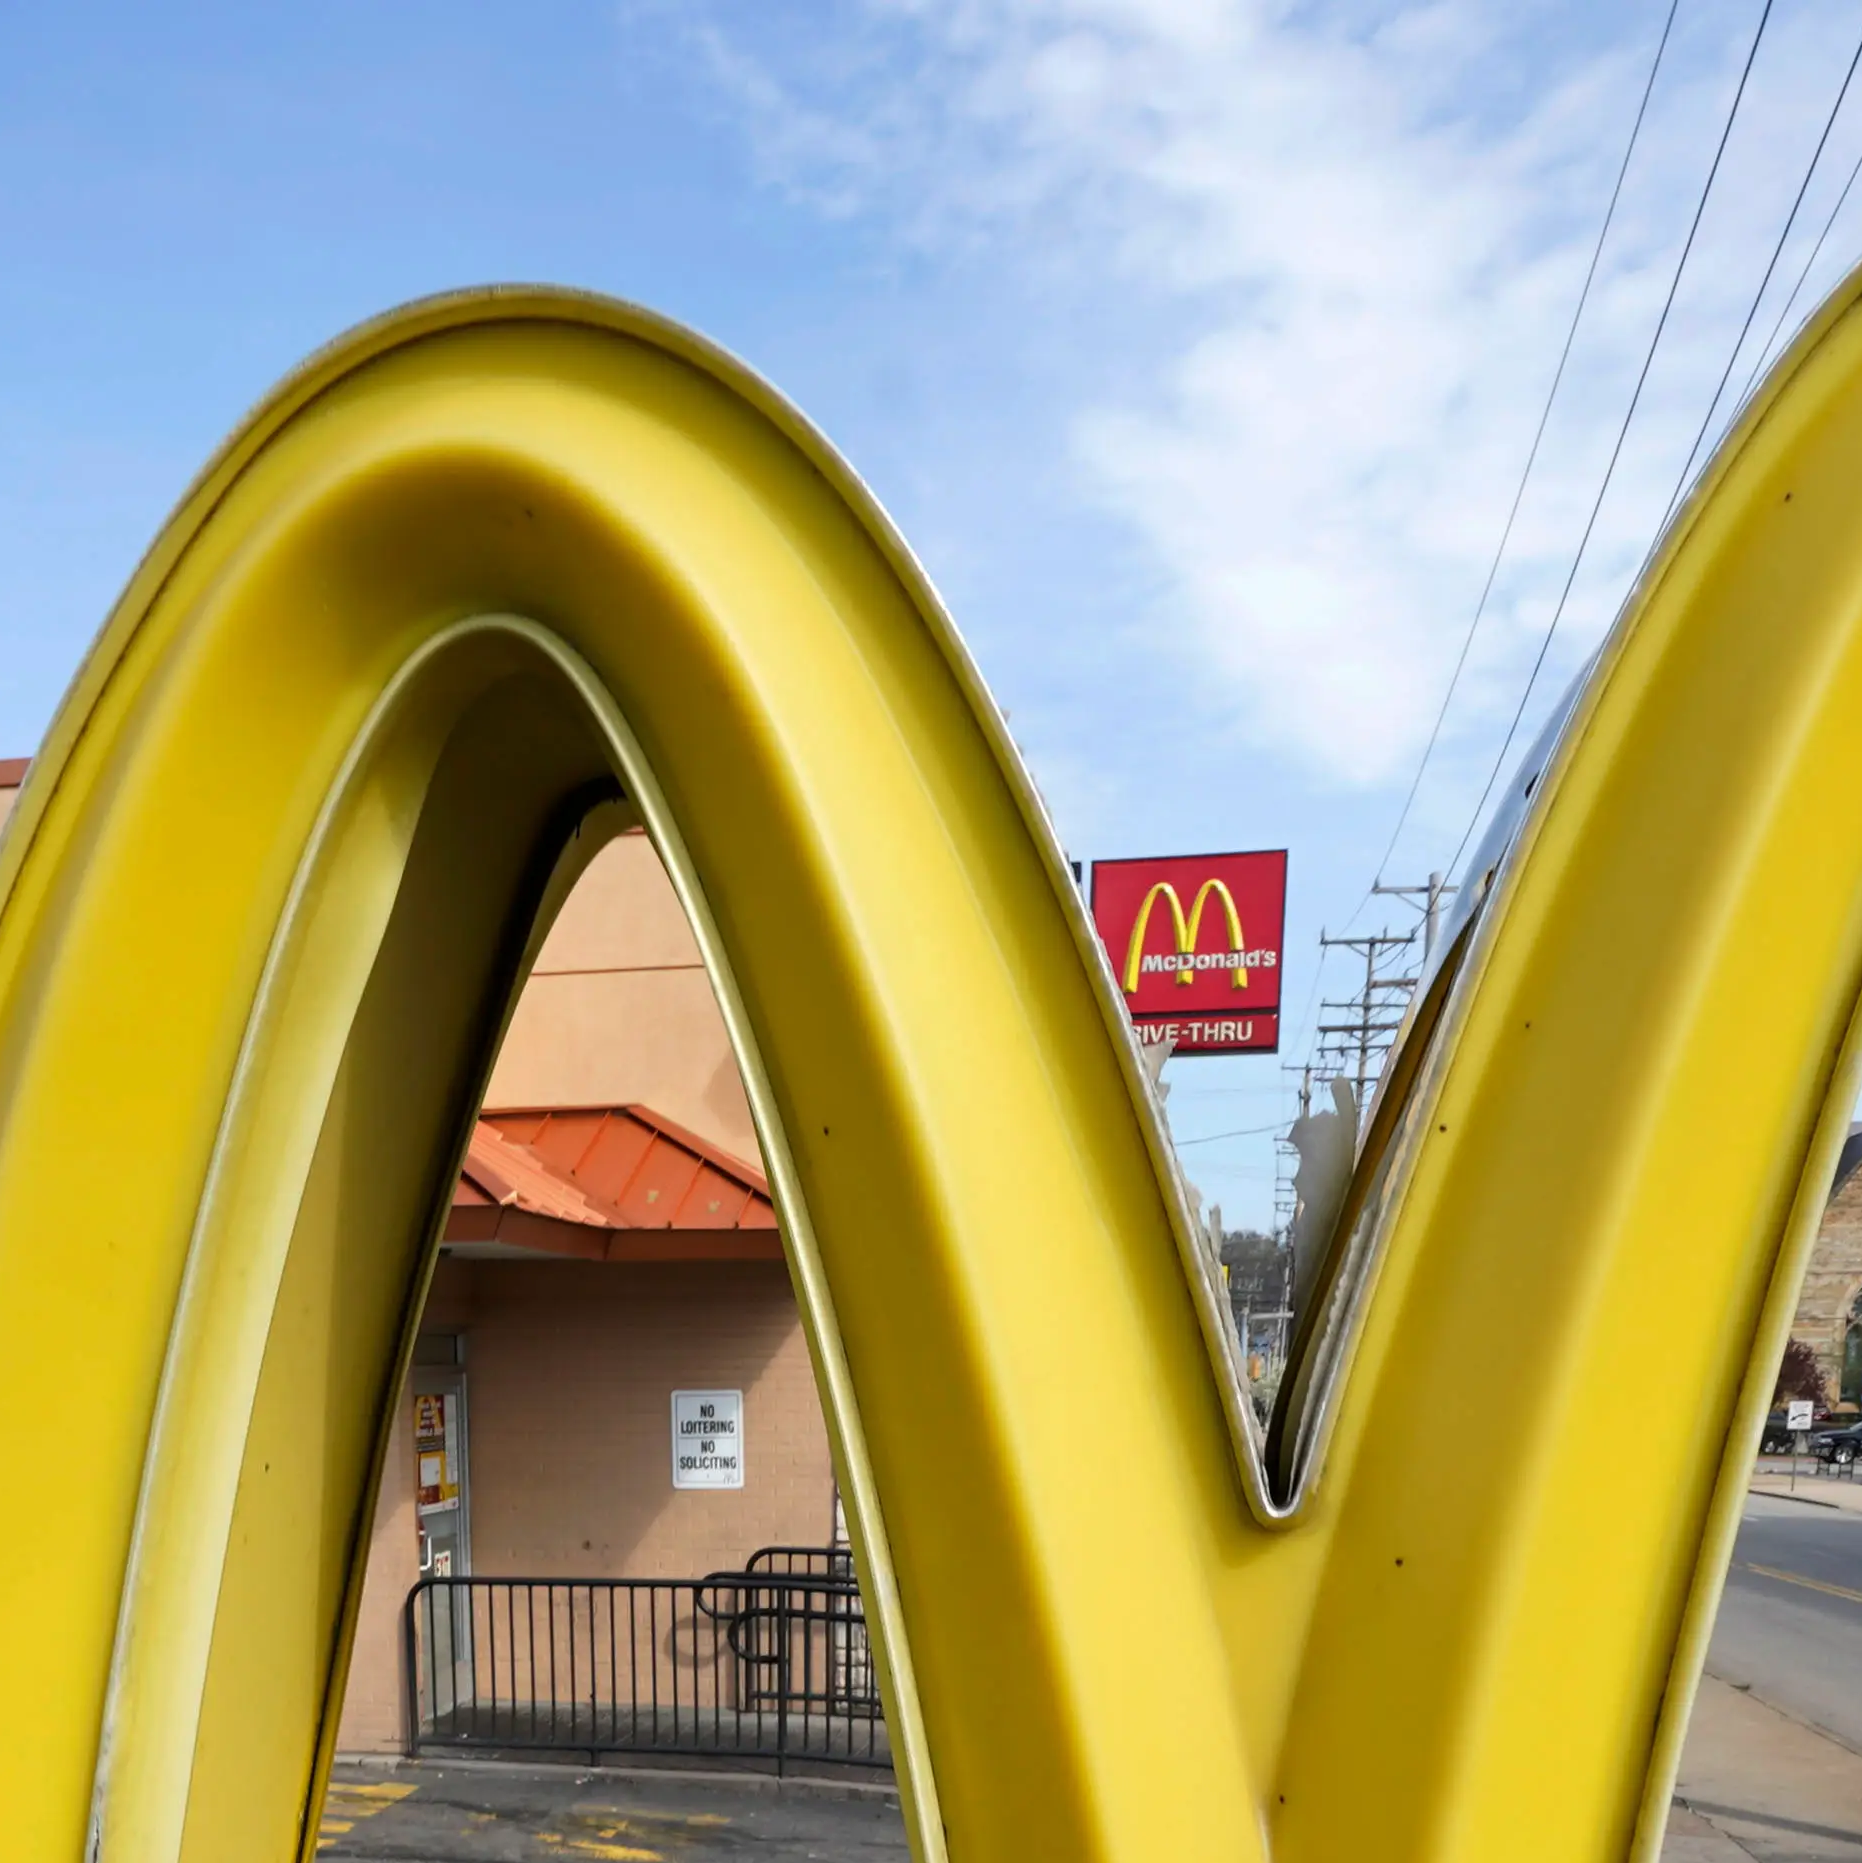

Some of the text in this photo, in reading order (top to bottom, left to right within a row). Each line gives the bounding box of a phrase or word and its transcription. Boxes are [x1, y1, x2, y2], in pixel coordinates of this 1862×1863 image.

[1142, 949, 1276, 973] McDonald's
[1132, 1021, 1252, 1043] RIVE-THRU
[700, 1405, 715, 1418] NO
[680, 1421, 735, 1435] LOITERING
[701, 1441, 715, 1453] NO
[680, 1457, 737, 1470] SOLICITING
